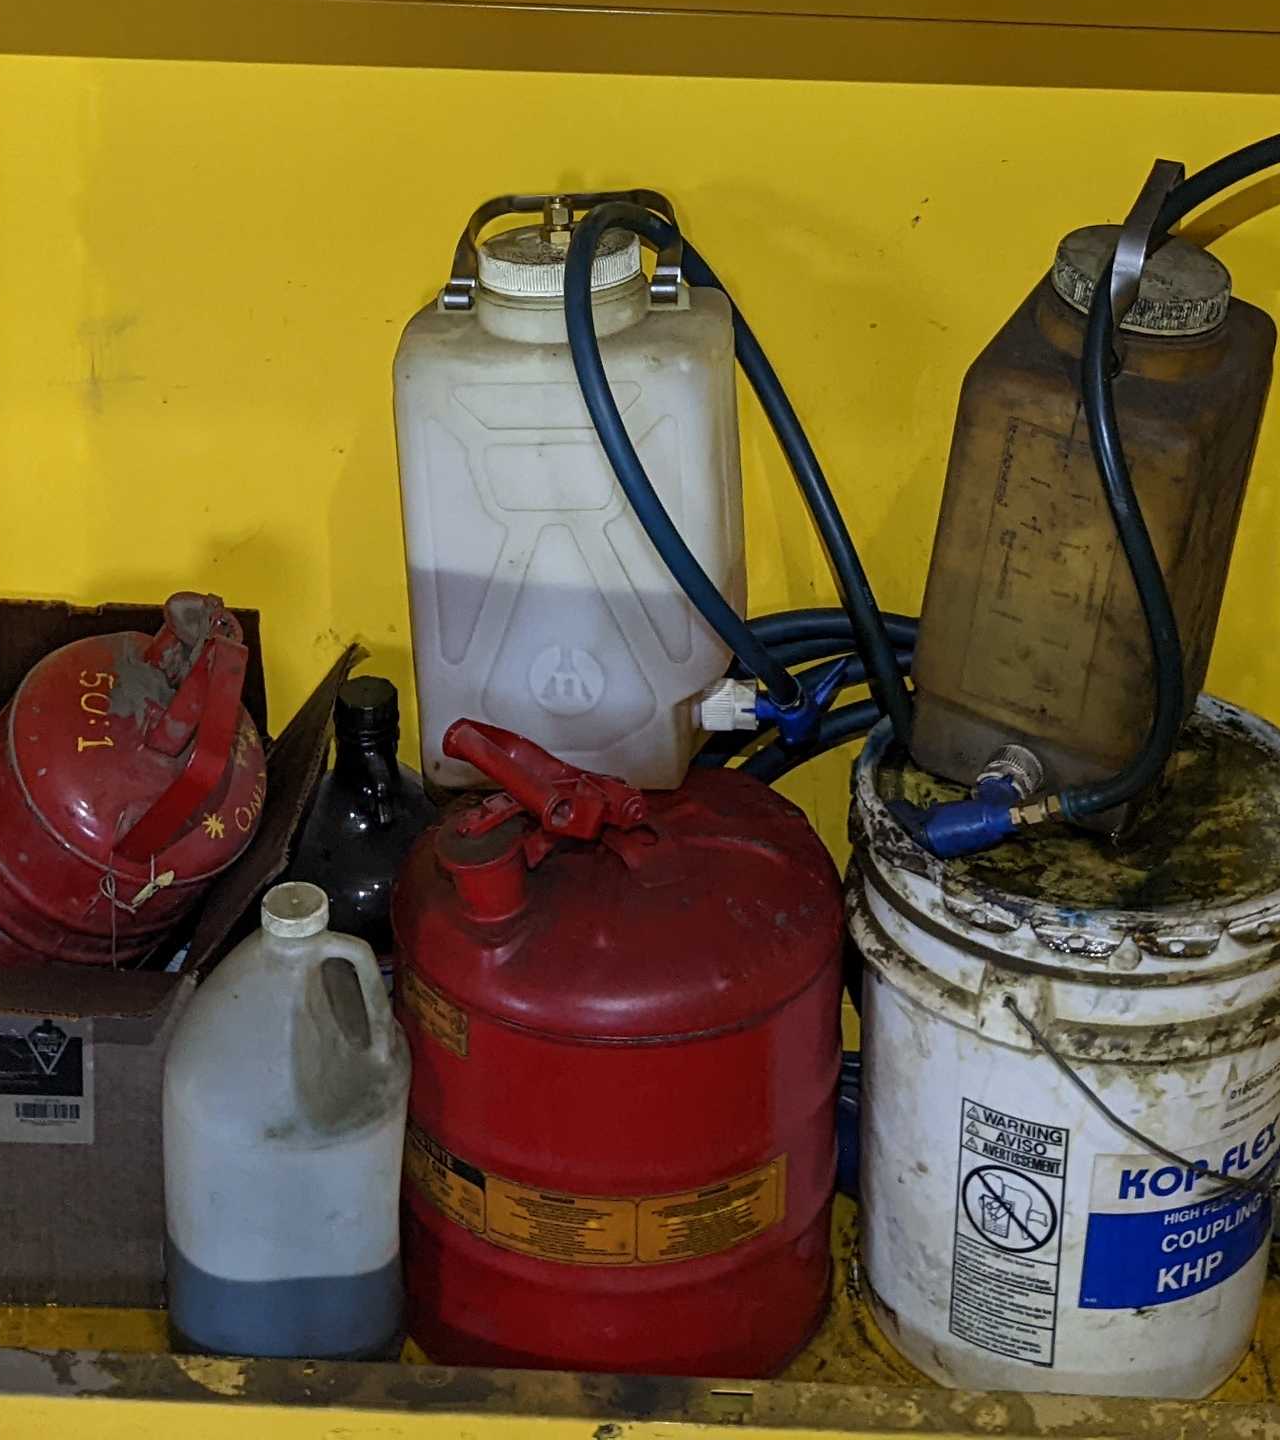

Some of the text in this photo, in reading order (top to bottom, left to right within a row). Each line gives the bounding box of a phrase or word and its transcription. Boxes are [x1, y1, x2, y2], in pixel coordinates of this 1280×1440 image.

[77, 670, 115, 753] 50:1
[983, 1110, 1063, 1143] WARNING
[982, 1142, 1061, 1174] AVERTISSEMENT
[995, 1132, 1047, 1156] AVISO
[1161, 1192, 1263, 1253] COUPLING
[1164, 1205, 1200, 1225] HIGH
[1156, 1250, 1224, 1293] KHP
